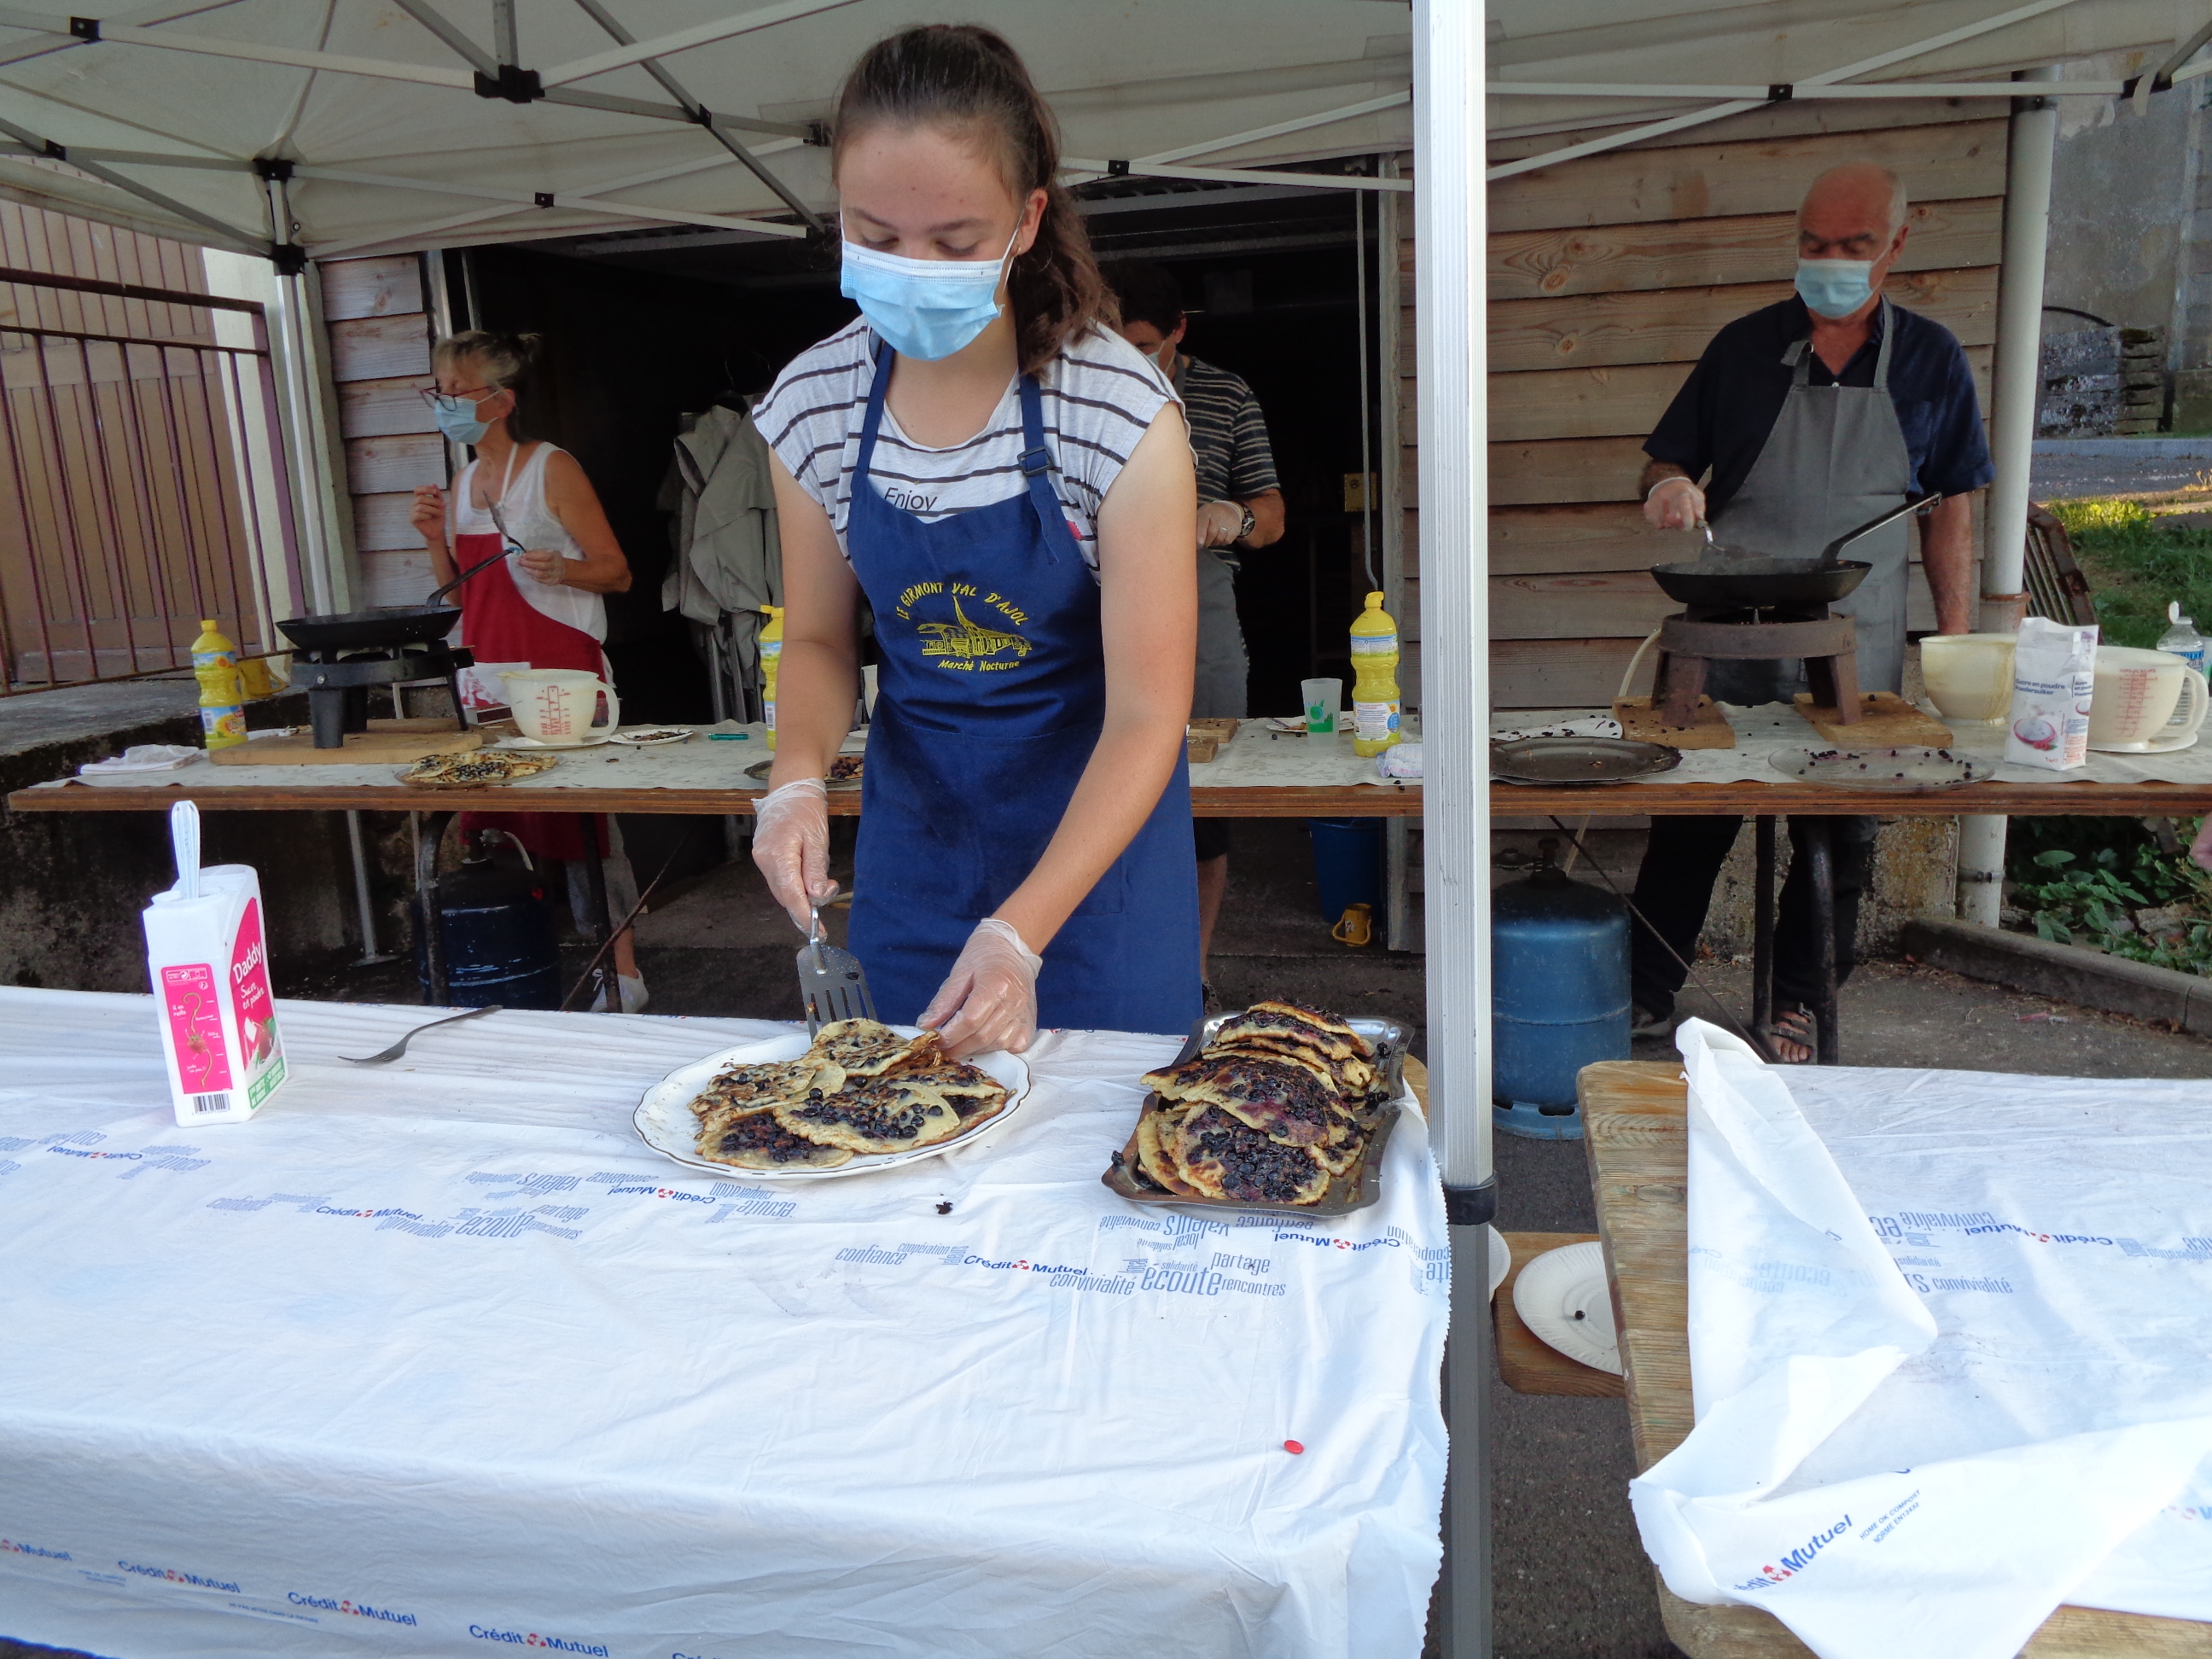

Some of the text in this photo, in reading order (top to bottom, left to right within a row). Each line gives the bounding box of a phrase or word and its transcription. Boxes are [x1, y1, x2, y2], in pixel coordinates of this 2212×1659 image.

[885, 487, 938, 511] Enjoy
[900, 582, 944, 608] GIRMONT
[952, 582, 977, 597] VAL
[938, 659, 1020, 672] Marché Nocturne
[232, 942, 263, 984] Daddy
[241, 982, 257, 998] Sucre
[608, 1186, 657, 1196] Mutuel
[1274, 1232, 1330, 1247] Mutuel
[835, 1243, 950, 1265] confiance coopération
[963, 1254, 1088, 1277] Crédit Mutuel
[1210, 1251, 1270, 1276] partage
[1050, 1263, 1286, 1296] convivialité écoute rencontres
[1932, 1277, 2014, 1294] convivialité
[1780, 1514, 1853, 1572] Mutuel
[288, 1592, 417, 1627] Crédit Mutuel
[469, 1625, 609, 1658] Crédit Mutuel
